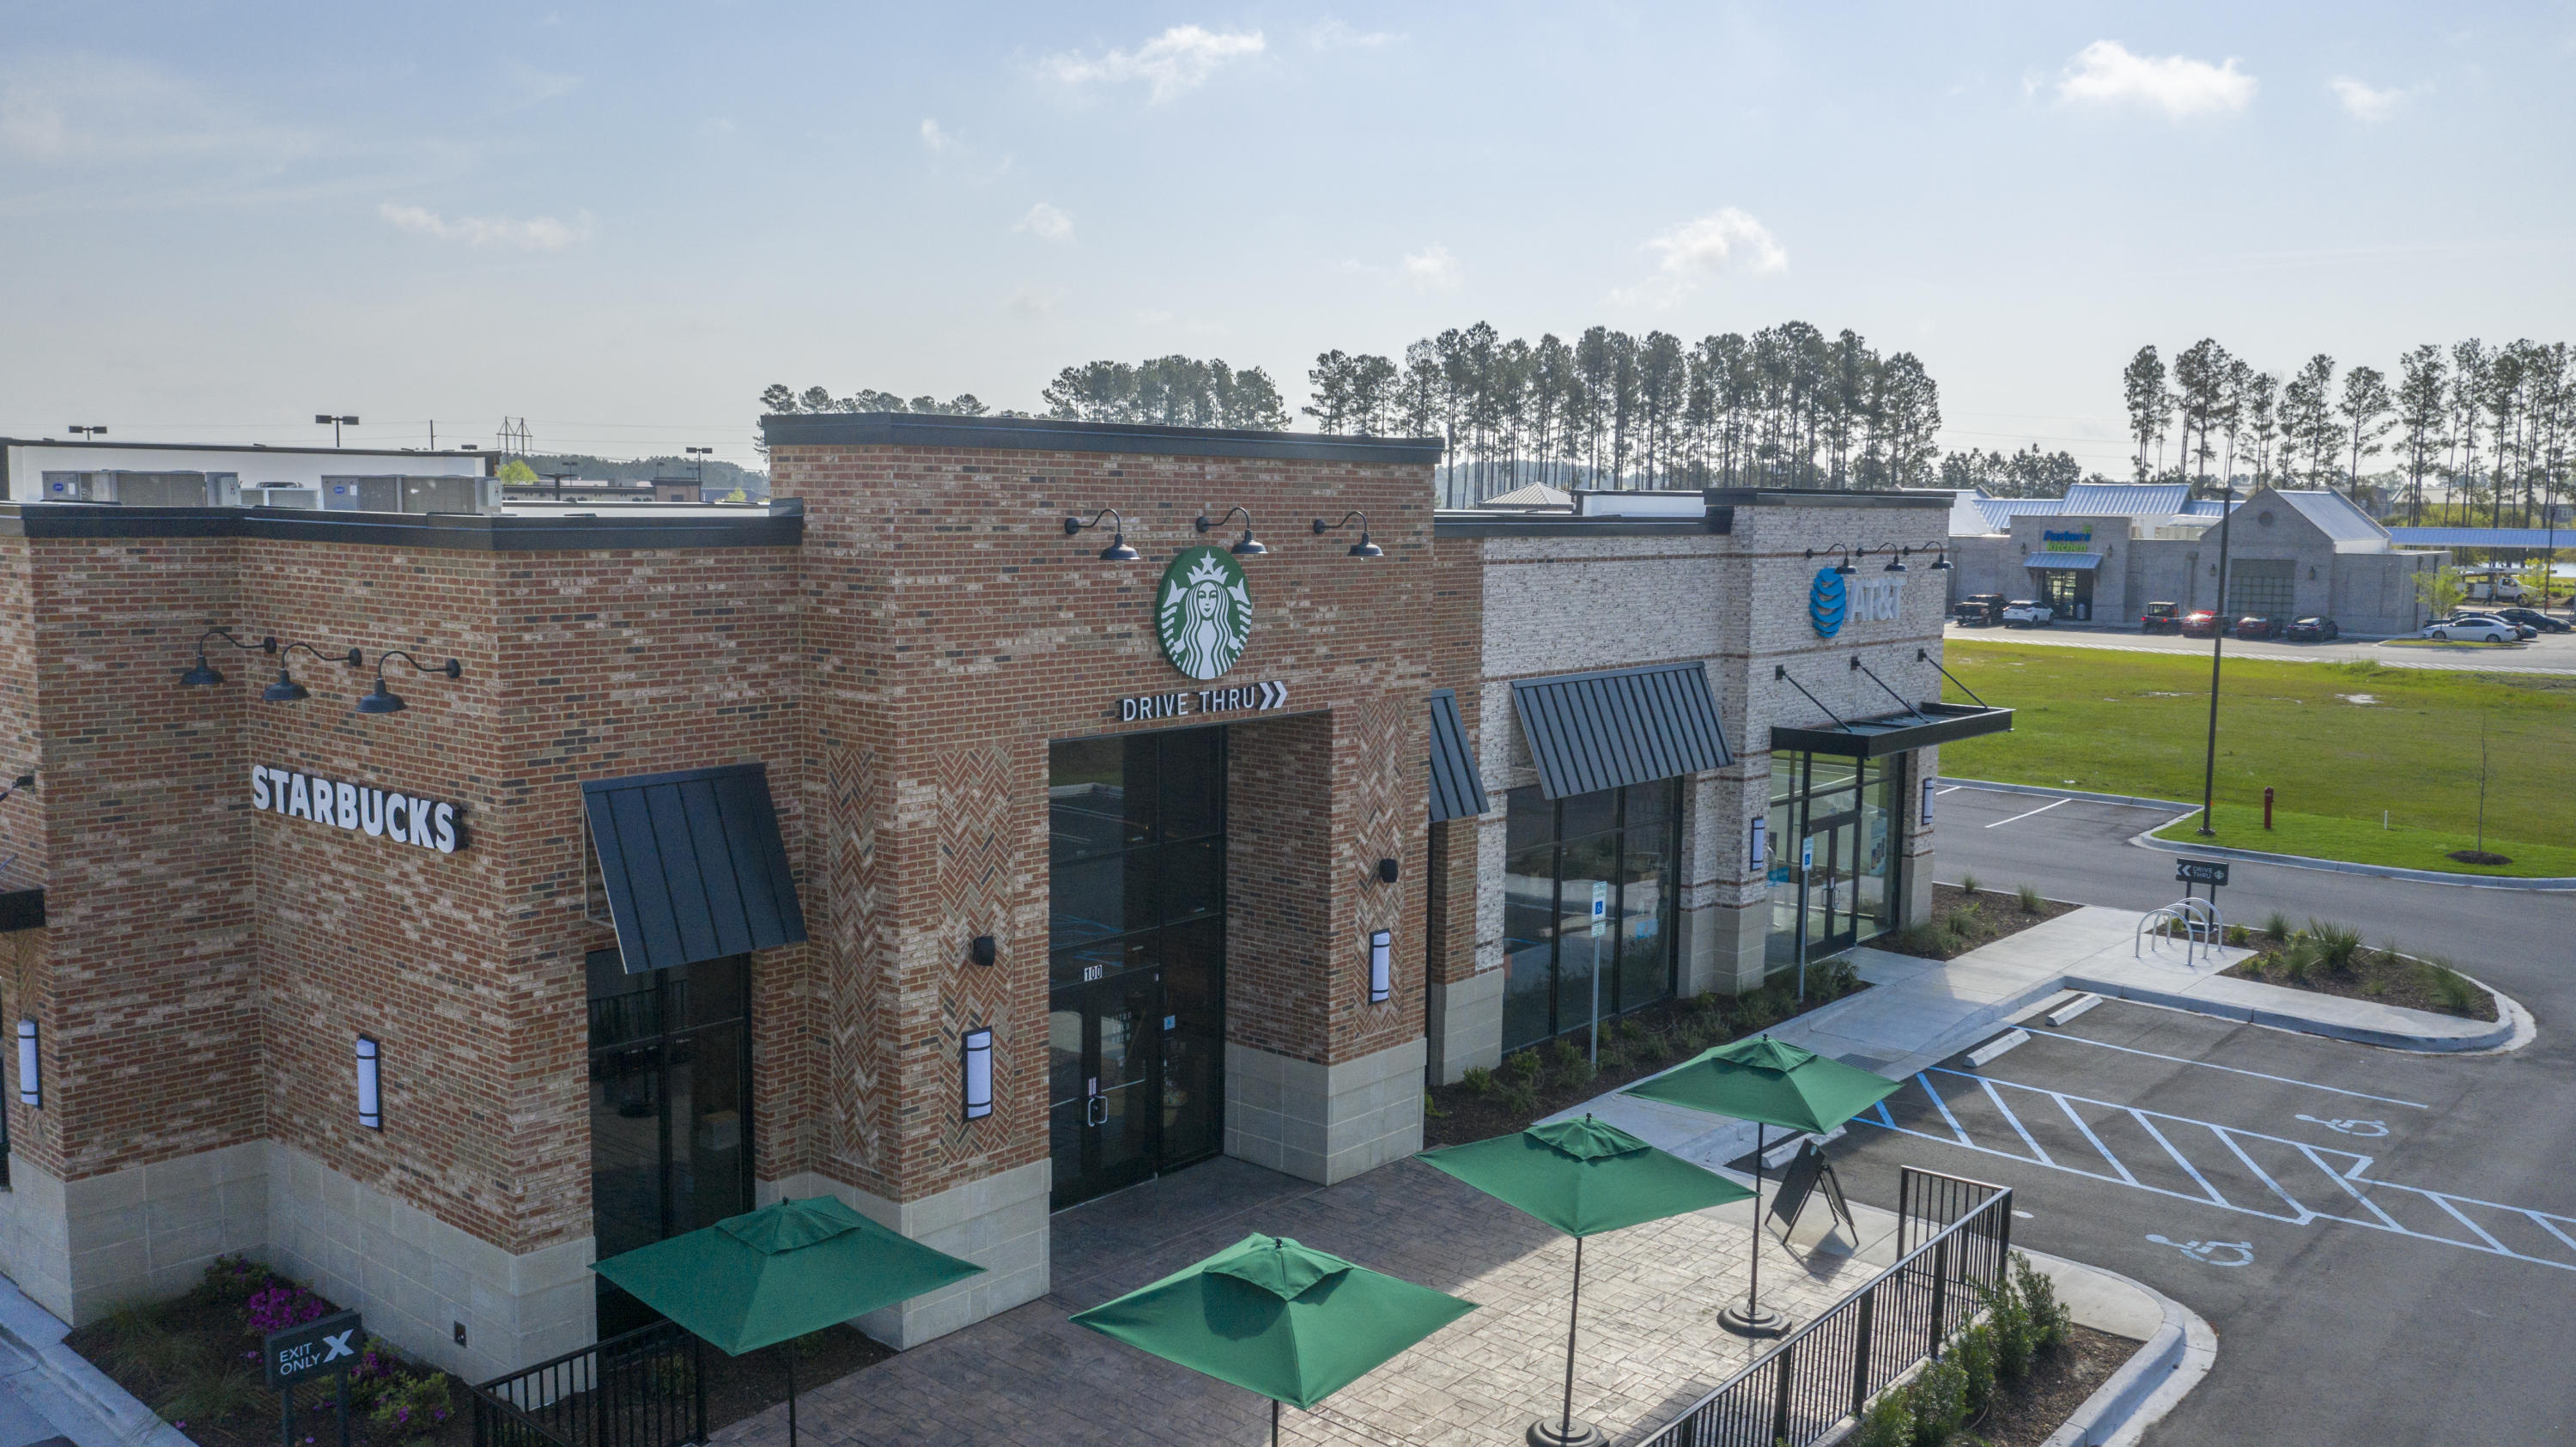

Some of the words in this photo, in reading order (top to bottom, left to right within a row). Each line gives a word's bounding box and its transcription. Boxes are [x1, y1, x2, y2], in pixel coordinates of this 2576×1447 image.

[1847, 577, 1907, 623] AT&T
[1121, 691, 1189, 722] DRIVE
[1199, 686, 1255, 714] THRU
[252, 764, 456, 854] STARBUCKS
[2192, 871, 2213, 879] THRU
[1084, 964, 1103, 982] 100
[279, 1342, 313, 1363] EXIT
[280, 1353, 321, 1376] ONLY
